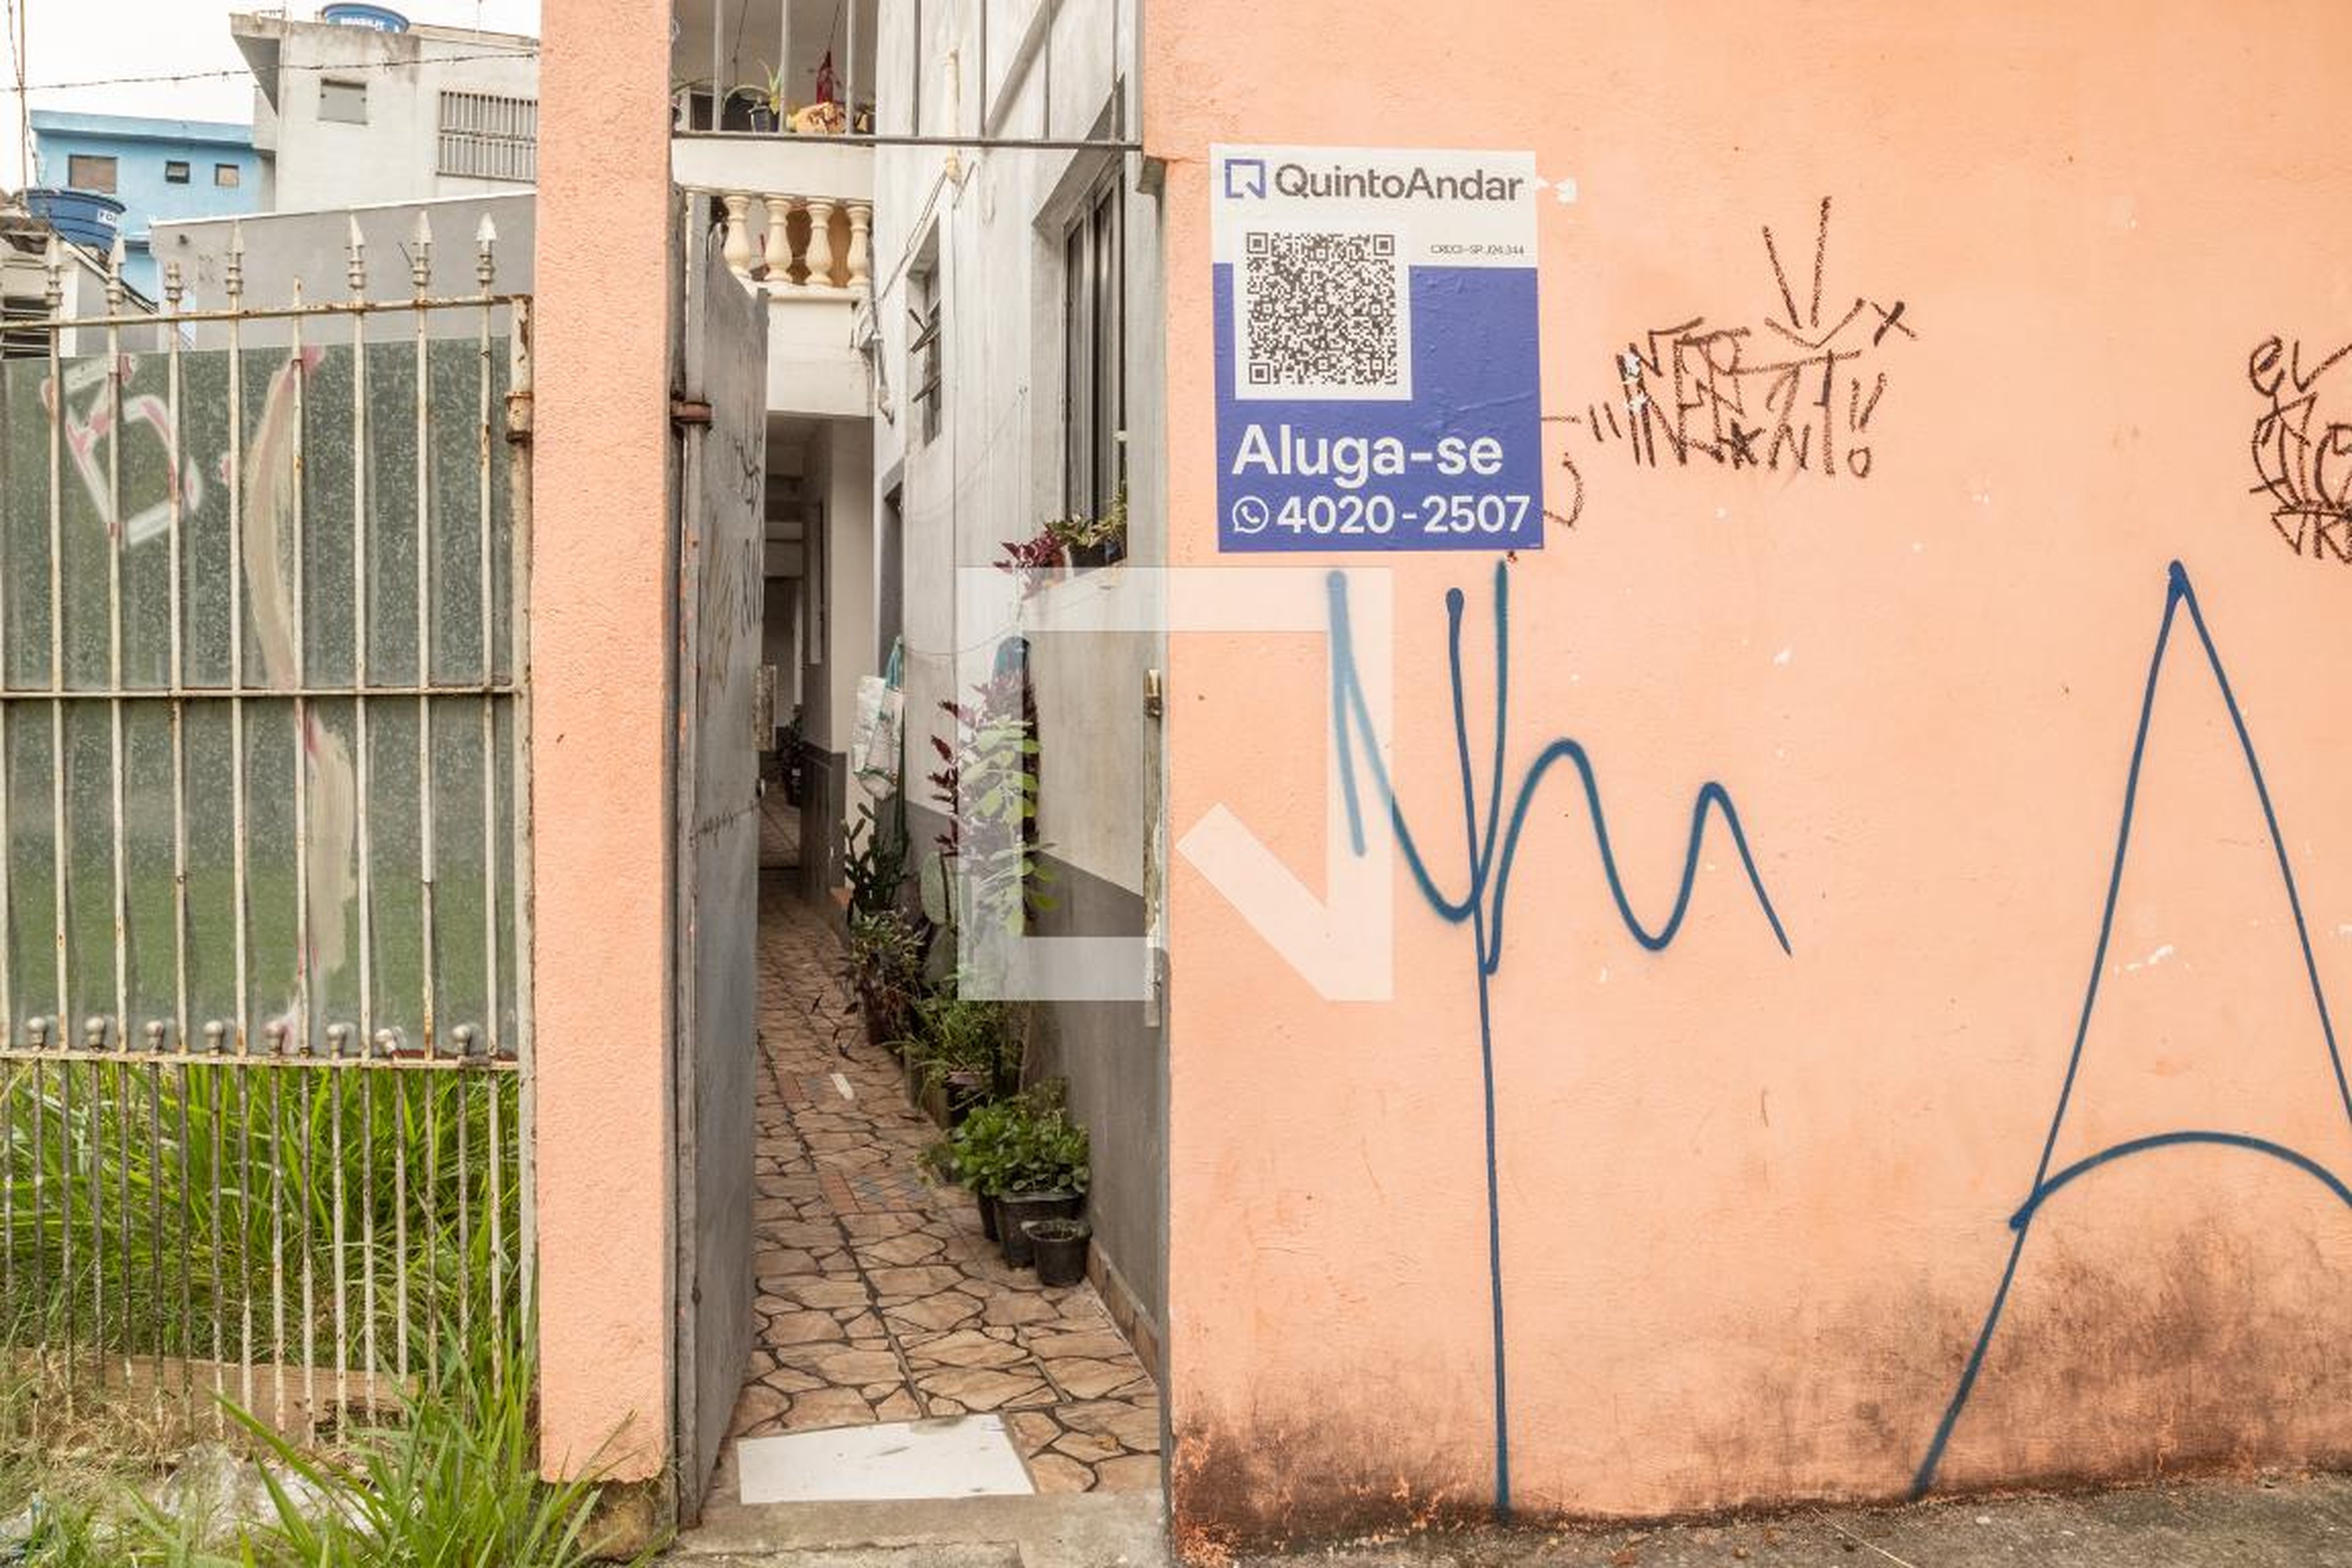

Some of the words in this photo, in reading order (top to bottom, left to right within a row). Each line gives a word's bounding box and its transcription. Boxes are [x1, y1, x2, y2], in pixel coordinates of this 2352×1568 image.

[1275, 164, 1524, 201] QuintoAndar
[1232, 424, 1502, 488] Aluga-se
[1277, 494, 1530, 533] 4020-2507
